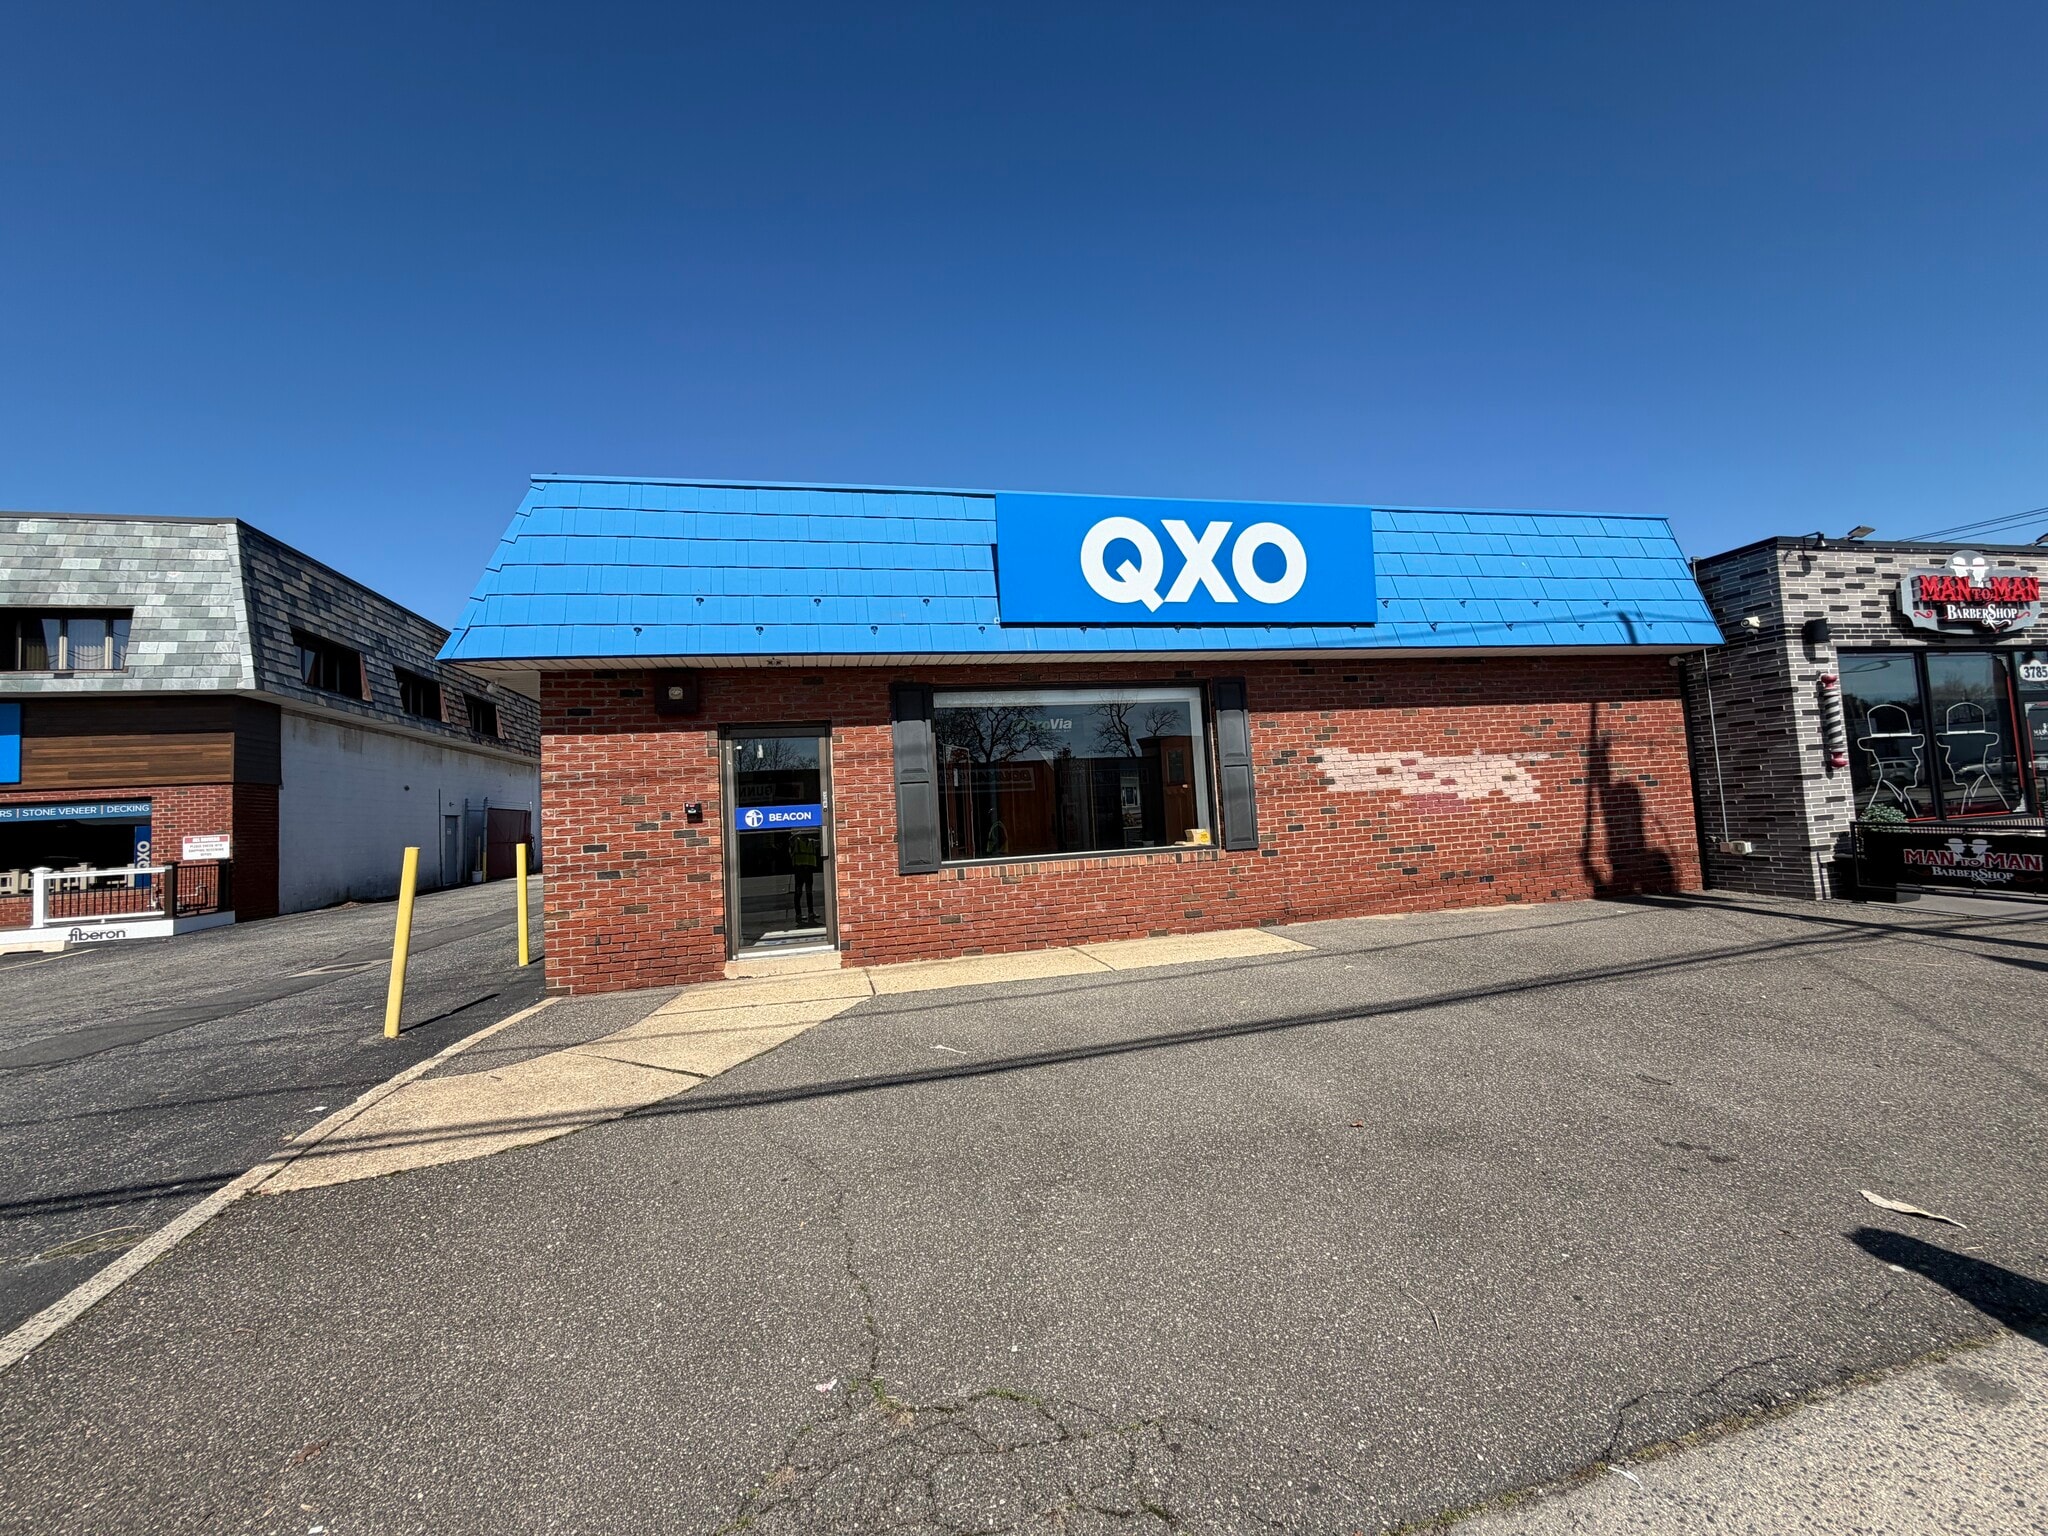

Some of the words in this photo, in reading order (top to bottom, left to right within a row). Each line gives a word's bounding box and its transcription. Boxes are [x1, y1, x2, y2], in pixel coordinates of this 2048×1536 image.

[1080, 516, 1307, 613] QXO
[1919, 575, 1971, 602] MAN
[1972, 588, 1991, 600] TO
[1990, 576, 2040, 602] MAN
[2023, 666, 2048, 679] 3785
[22, 808, 56, 817] STONE
[58, 806, 97, 815] VENEER
[106, 804, 150, 813] DECKING
[768, 812, 812, 822] BEACON
[1903, 849, 1956, 866] MAN
[1961, 859, 1982, 867] TO
[1984, 852, 2044, 871] MAN
[68, 927, 126, 941] fiberon
